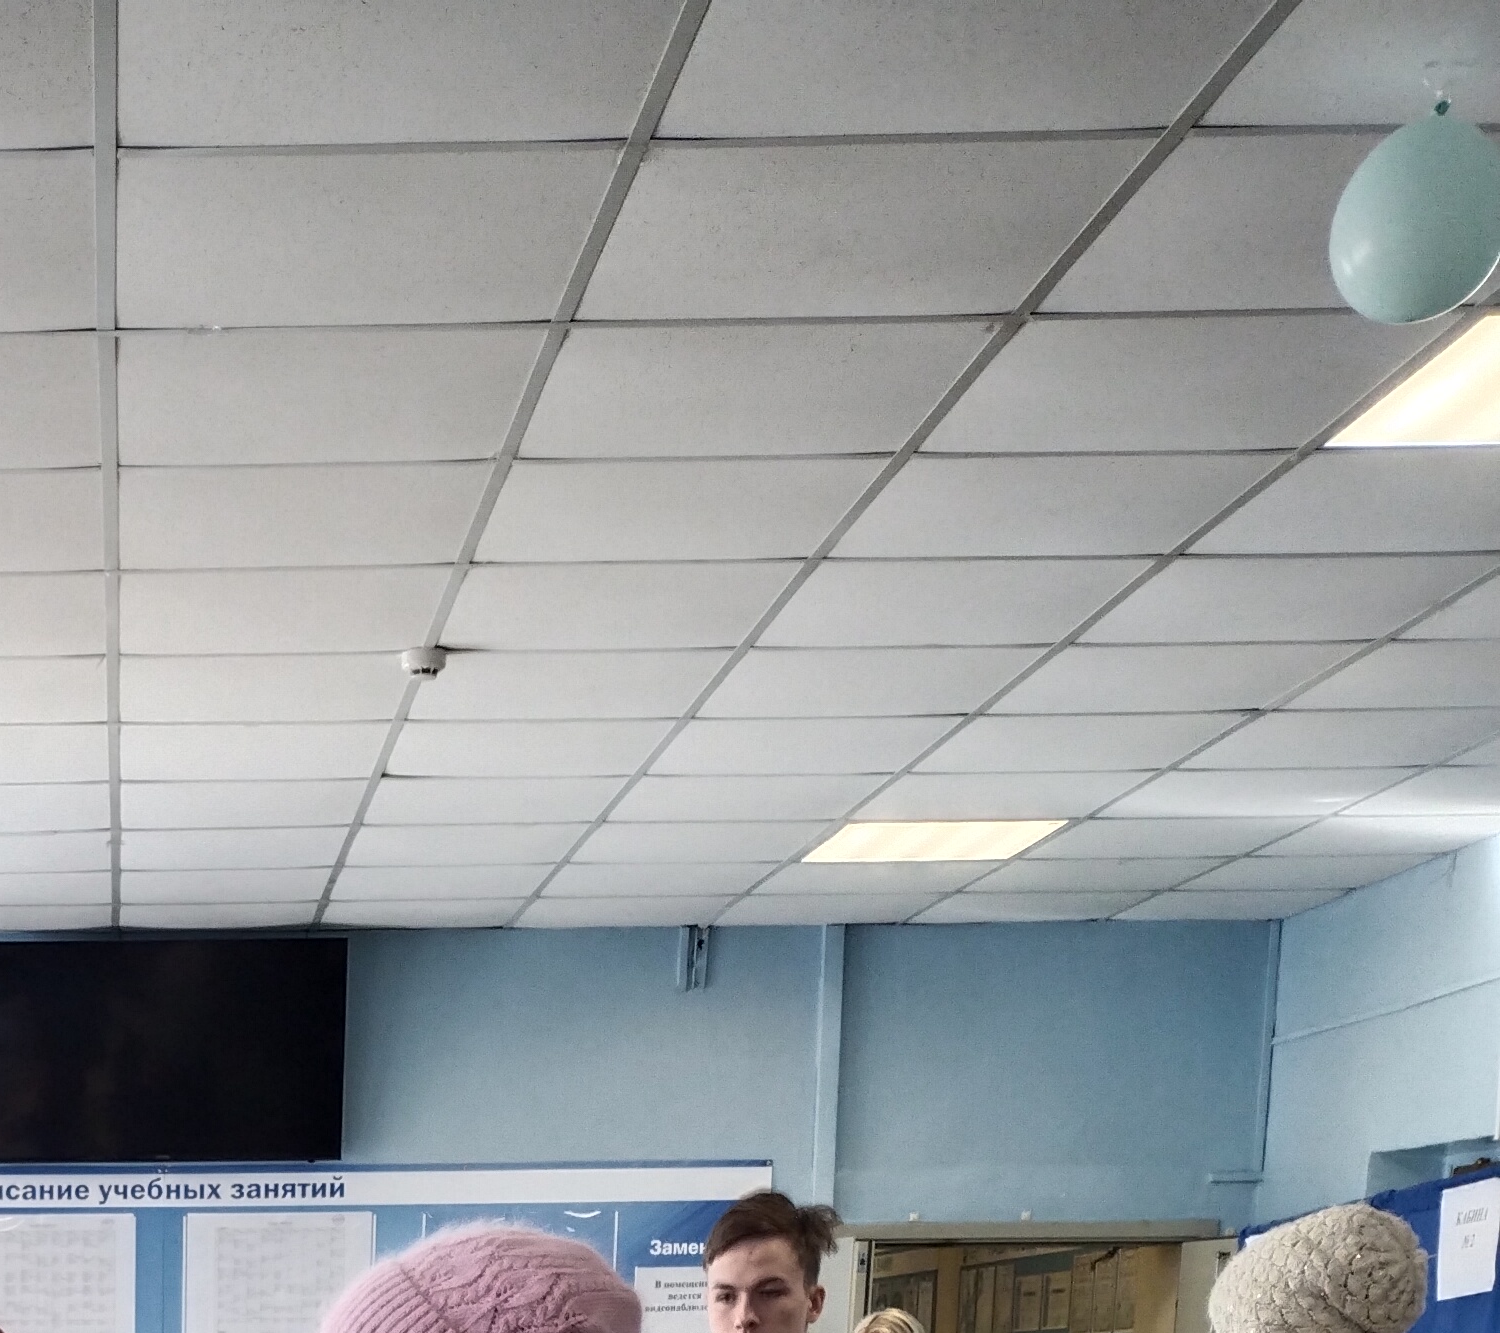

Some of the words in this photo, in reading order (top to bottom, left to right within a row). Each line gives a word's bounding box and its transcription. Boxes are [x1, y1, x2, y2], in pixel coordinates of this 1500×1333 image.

[99, 1177, 222, 1205] учебных
[230, 1175, 345, 1199] занятий
[649, 1239, 707, 1256] Замен
[655, 1280, 662, 1289] В
[664, 1280, 708, 1289] помещени
[644, 1303, 708, 1312] видеонаблюде
